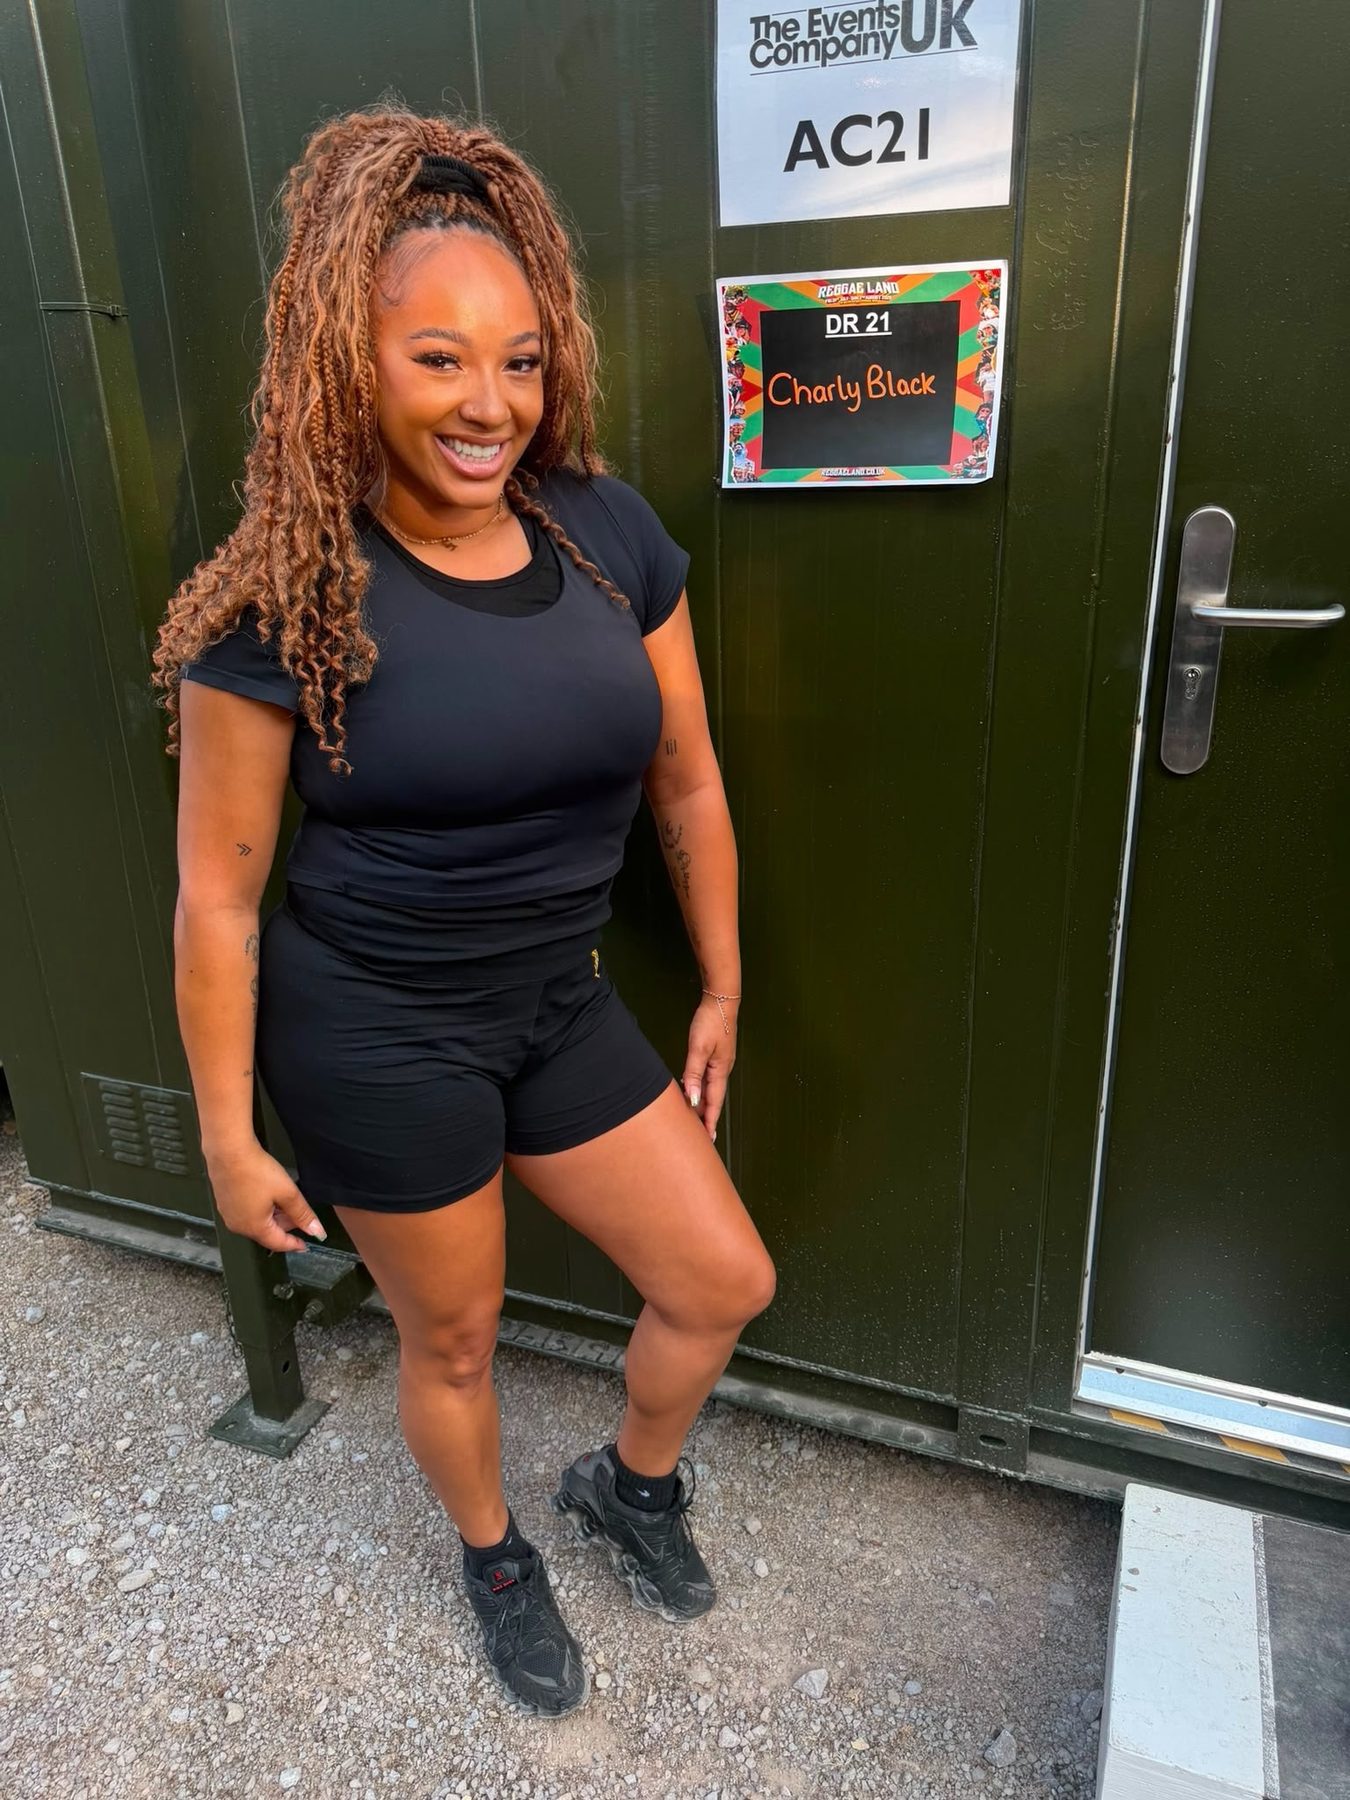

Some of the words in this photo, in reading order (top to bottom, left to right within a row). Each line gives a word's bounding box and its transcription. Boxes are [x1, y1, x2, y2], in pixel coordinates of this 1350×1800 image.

[750, 15, 800, 43] The
[807, 0, 900, 38] Events
[900, 0, 978, 53] UK
[750, 28, 900, 68] Company
[783, 108, 930, 172] AC21
[818, 282, 864, 299] REGGAE
[866, 281, 899, 295] LAND
[826, 313, 859, 335] DR
[865, 311, 889, 333] 21
[768, 372, 861, 412] Charly
[866, 364, 936, 399] Black
